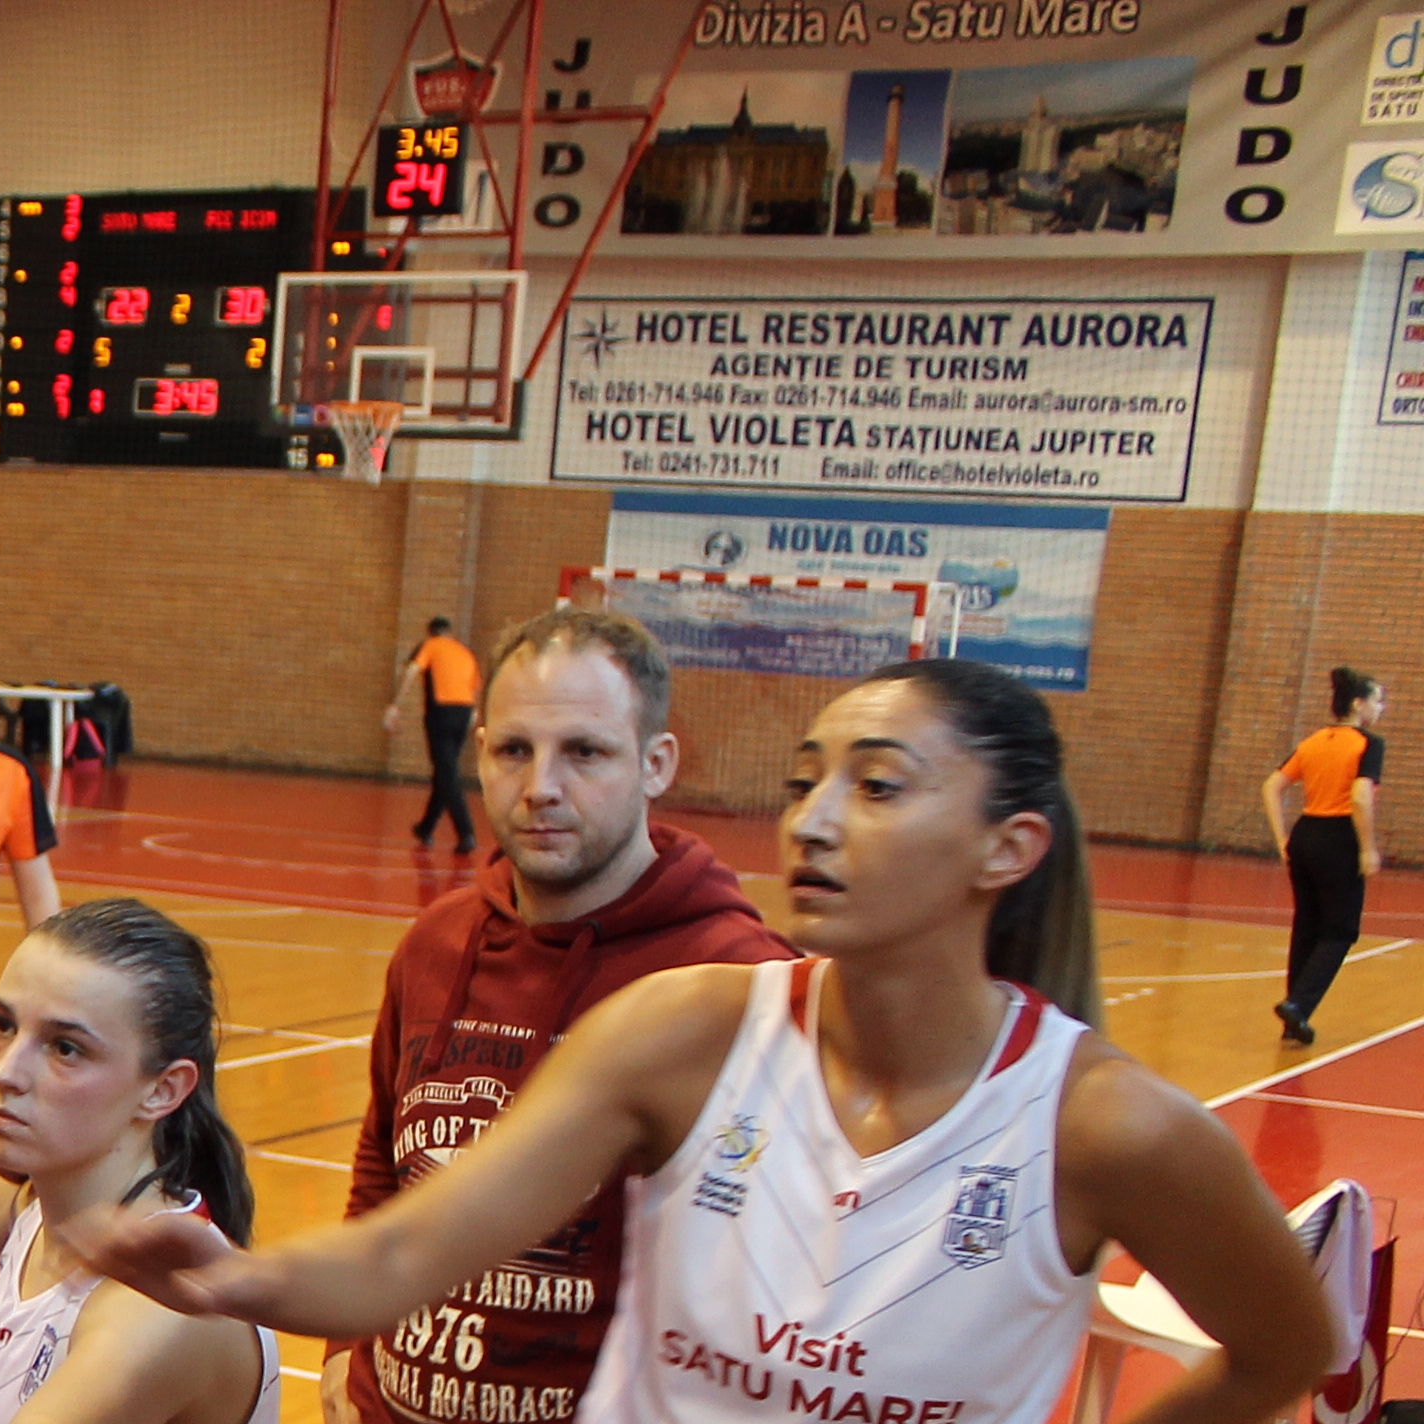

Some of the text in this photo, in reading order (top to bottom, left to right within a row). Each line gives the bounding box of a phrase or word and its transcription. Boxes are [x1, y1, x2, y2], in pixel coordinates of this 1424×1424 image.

[693, 0, 828, 48] Divizia
[835, 2, 869, 47] A
[904, 0, 1005, 43] Satu
[1015, 0, 1140, 38] Mare
[1224, 6, 1307, 225] JUDO
[1368, 102, 1419, 119] SATU
[386, 161, 448, 210] 24
[107, 287, 150, 325] 22
[170, 293, 192, 325] 2
[223, 286, 267, 325] 30
[635, 311, 1189, 348] HOTEL RESTAURANT AURORA
[93, 336, 112, 368] 5
[245, 337, 267, 370] 2
[854, 354, 895, 380] DE
[905, 355, 1029, 381] TURISM
[153, 378, 220, 416] 3:45
[908, 386, 968, 411] Email:
[585, 409, 696, 444] HOTEL
[709, 412, 857, 448] VIOLETA
[1029, 429, 1156, 457] JUPITER
[821, 456, 880, 481] Email:
[767, 521, 855, 555] NOVA
[432, 1115, 465, 1147] OF
[447, 1270, 596, 1315] TANDARD
[392, 1303, 487, 1373] 1976
[754, 1313, 869, 1377] Visit
[658, 1328, 774, 1401] SATU
